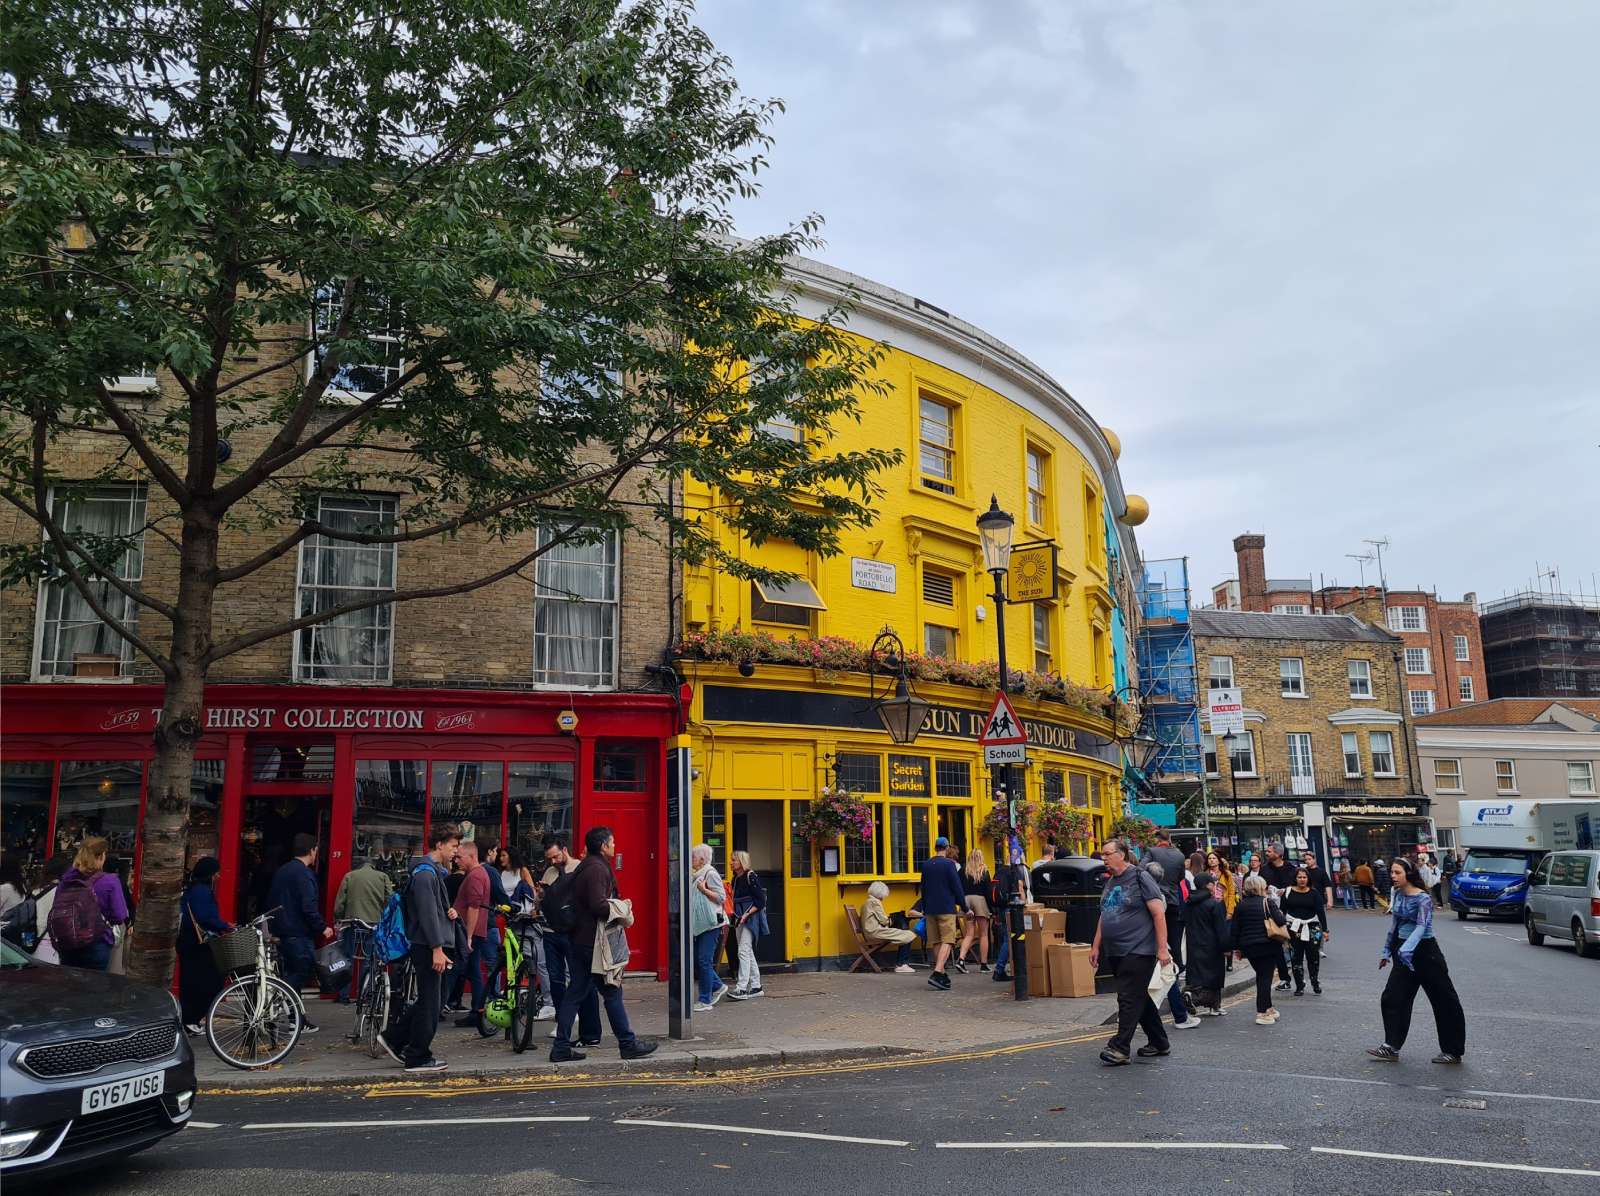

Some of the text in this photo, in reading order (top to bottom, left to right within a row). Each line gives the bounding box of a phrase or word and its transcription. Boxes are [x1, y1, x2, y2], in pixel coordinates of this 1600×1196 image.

[855, 570, 893, 584] PORTOBELLO
[858, 579, 877, 588] ROAD
[206, 708, 424, 729] HIRST COLLECTION
[921, 708, 961, 734] SUN
[1024, 721, 1077, 750] ENDOUR
[989, 750, 1020, 759] School
[893, 762, 923, 776] Secret
[891, 777, 925, 791] Garden
[1484, 807, 1508, 816] ATLAS
[90, 1076, 159, 1109] GY67 USG
